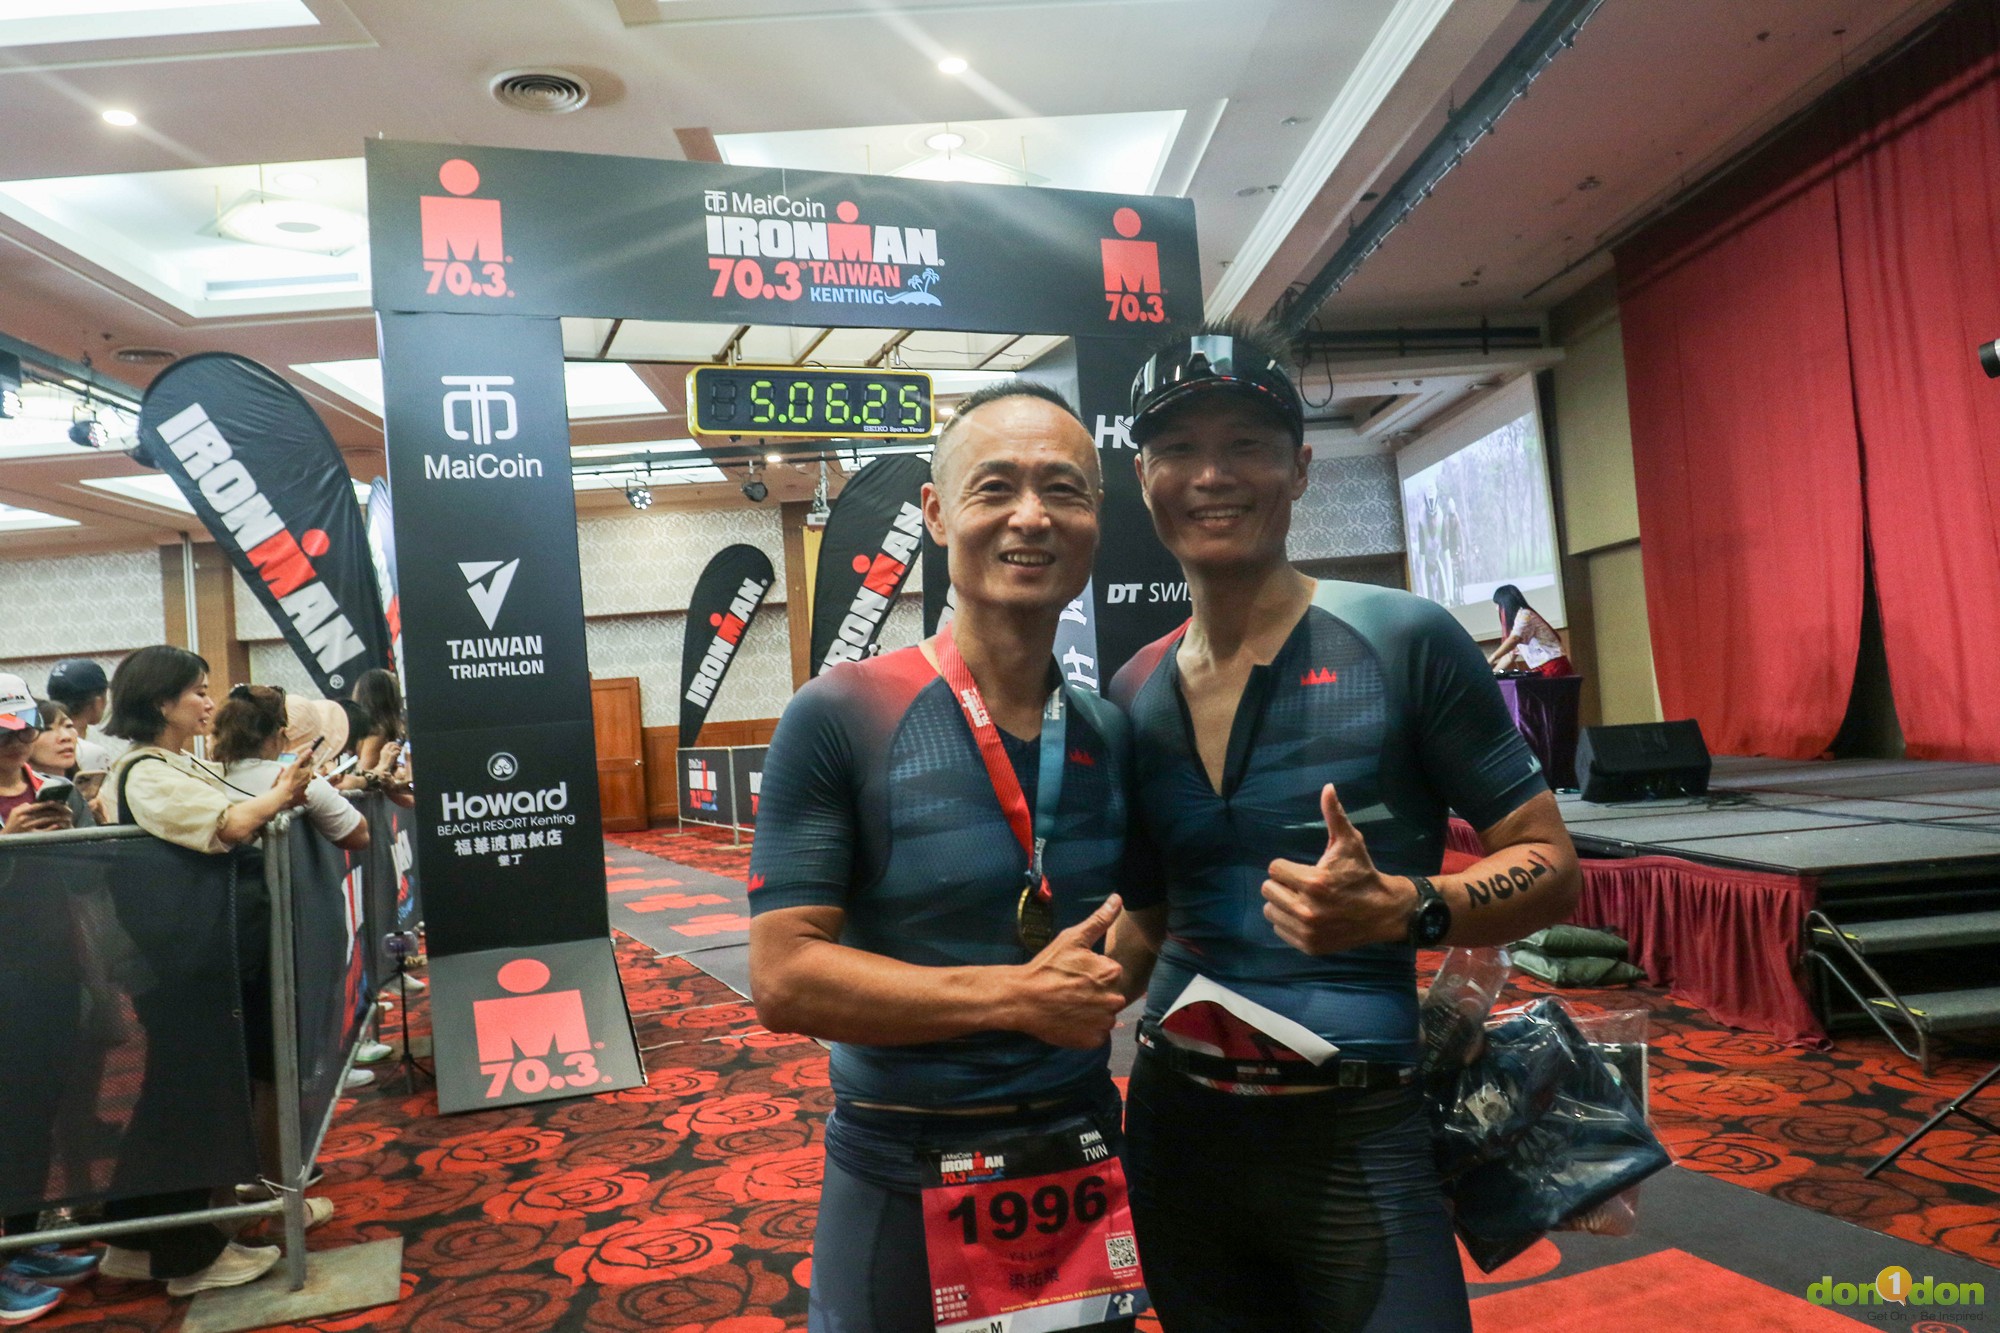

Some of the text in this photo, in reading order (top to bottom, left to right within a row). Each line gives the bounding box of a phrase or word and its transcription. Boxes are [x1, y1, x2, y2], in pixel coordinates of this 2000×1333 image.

[733, 192, 826, 219] MaiCoin
[705, 201, 940, 267] IRONMAN
[423, 260, 508, 298] 70.3
[708, 257, 901, 302] 70.3 TAIWAN
[810, 286, 885, 304] KENTING
[1105, 292, 1165, 323] 70.3
[423, 452, 543, 480] MaiCoin
[156, 402, 367, 675] IRONMAN
[1106, 582, 1193, 604] DT SWI
[446, 635, 543, 660] TAIWAN
[685, 577, 764, 709] IRONMAN
[448, 660, 544, 680] TRIATHLON
[441, 781, 568, 822] Howard
[437, 813, 576, 836] BEACH RESORT Kenting
[454, 829, 563, 857] 福華渡假飯店
[480, 1052, 600, 1099] 70.3
[940, 1152, 1005, 1173] IRONMAN
[1082, 1143, 1109, 1162] TWN
[941, 1171, 967, 1185] 70.3
[948, 1175, 1108, 1245] 1996
